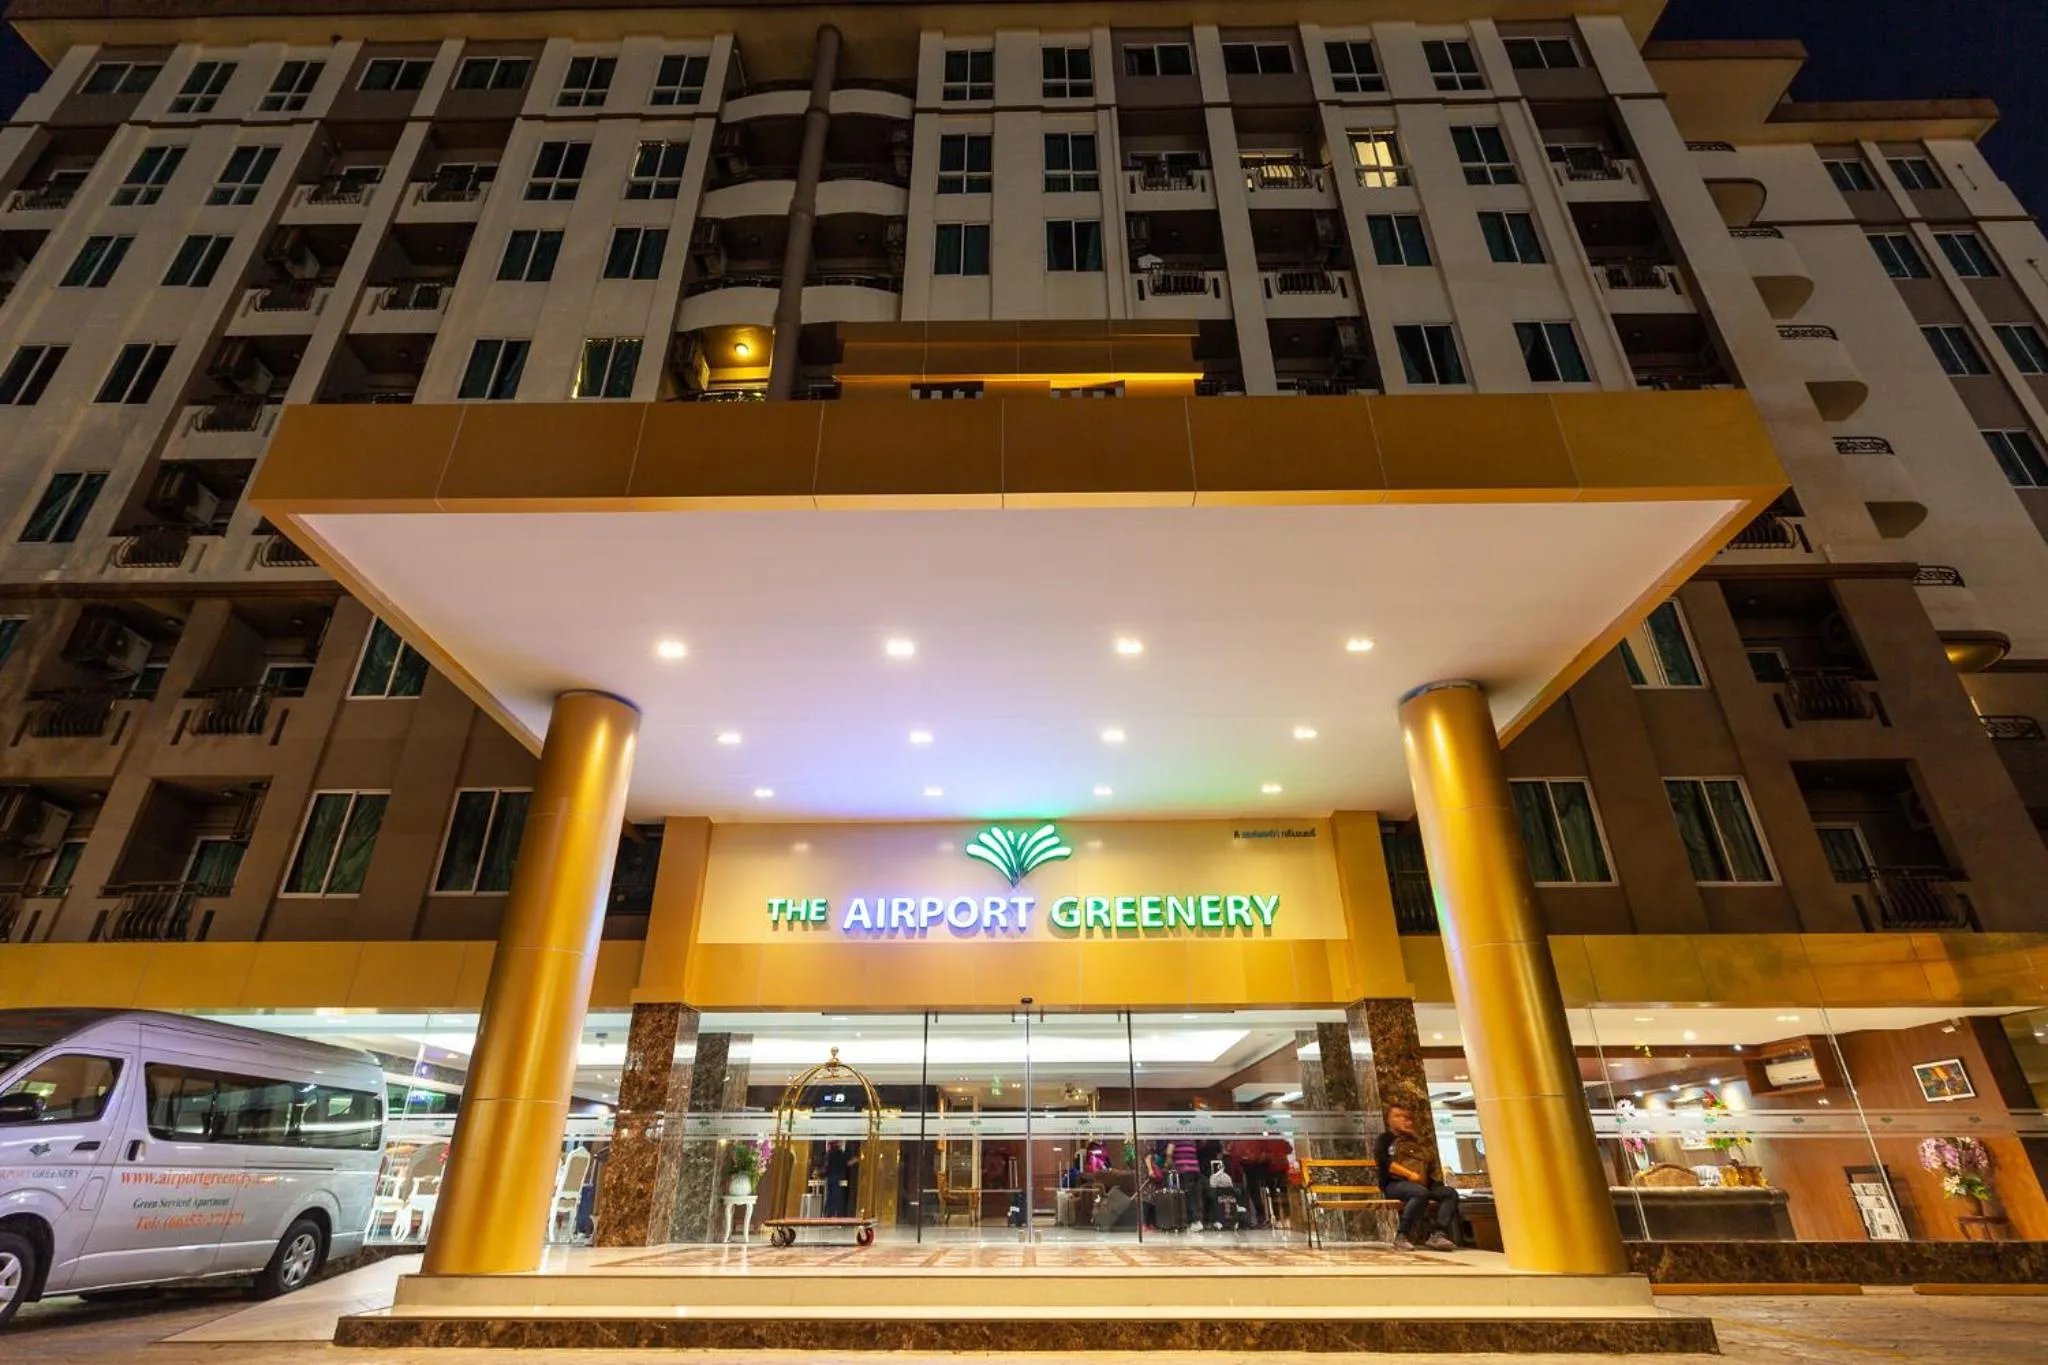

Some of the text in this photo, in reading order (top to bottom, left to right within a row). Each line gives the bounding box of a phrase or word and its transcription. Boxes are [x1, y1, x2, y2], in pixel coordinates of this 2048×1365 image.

[768, 895, 1280, 930] THE AIRPORT GREENERY
